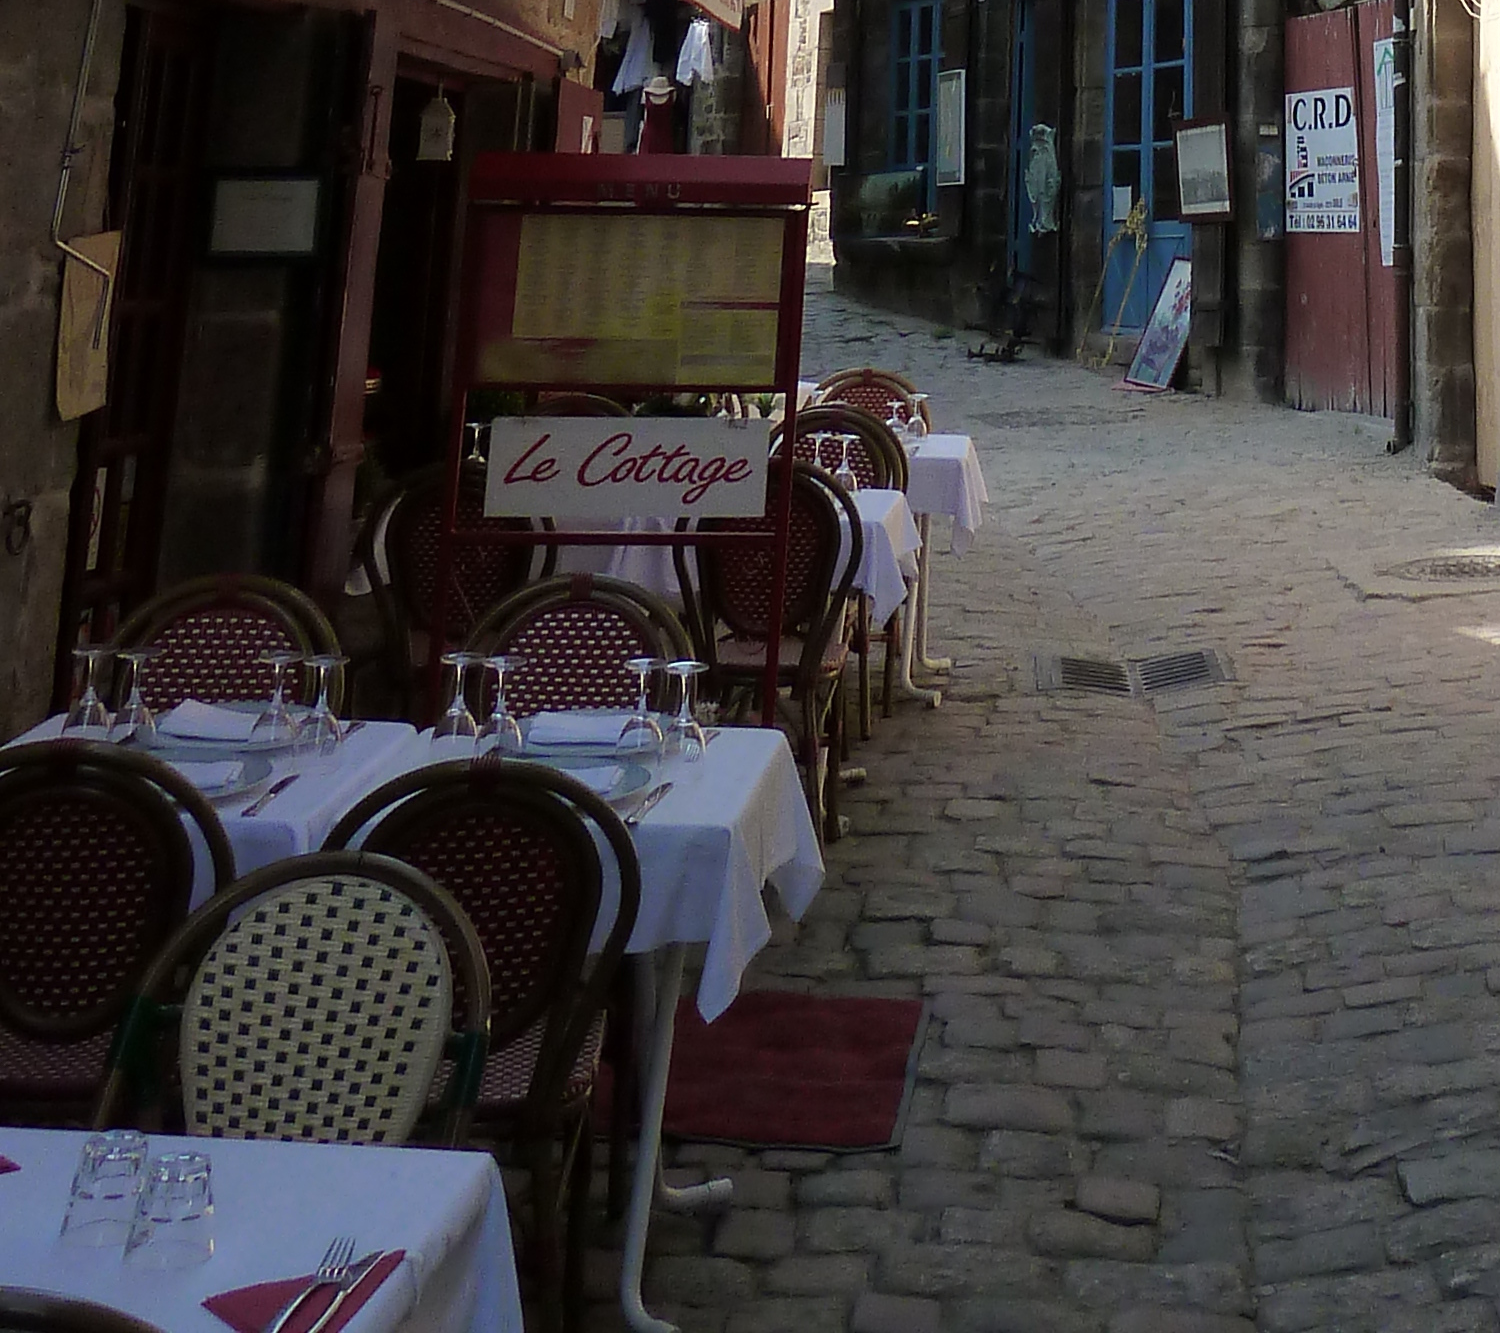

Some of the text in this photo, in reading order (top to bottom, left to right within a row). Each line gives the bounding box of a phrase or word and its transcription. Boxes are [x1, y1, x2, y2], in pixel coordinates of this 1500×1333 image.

[1293, 94, 1351, 131] C.R.D
[503, 433, 753, 505] Le Cottage
